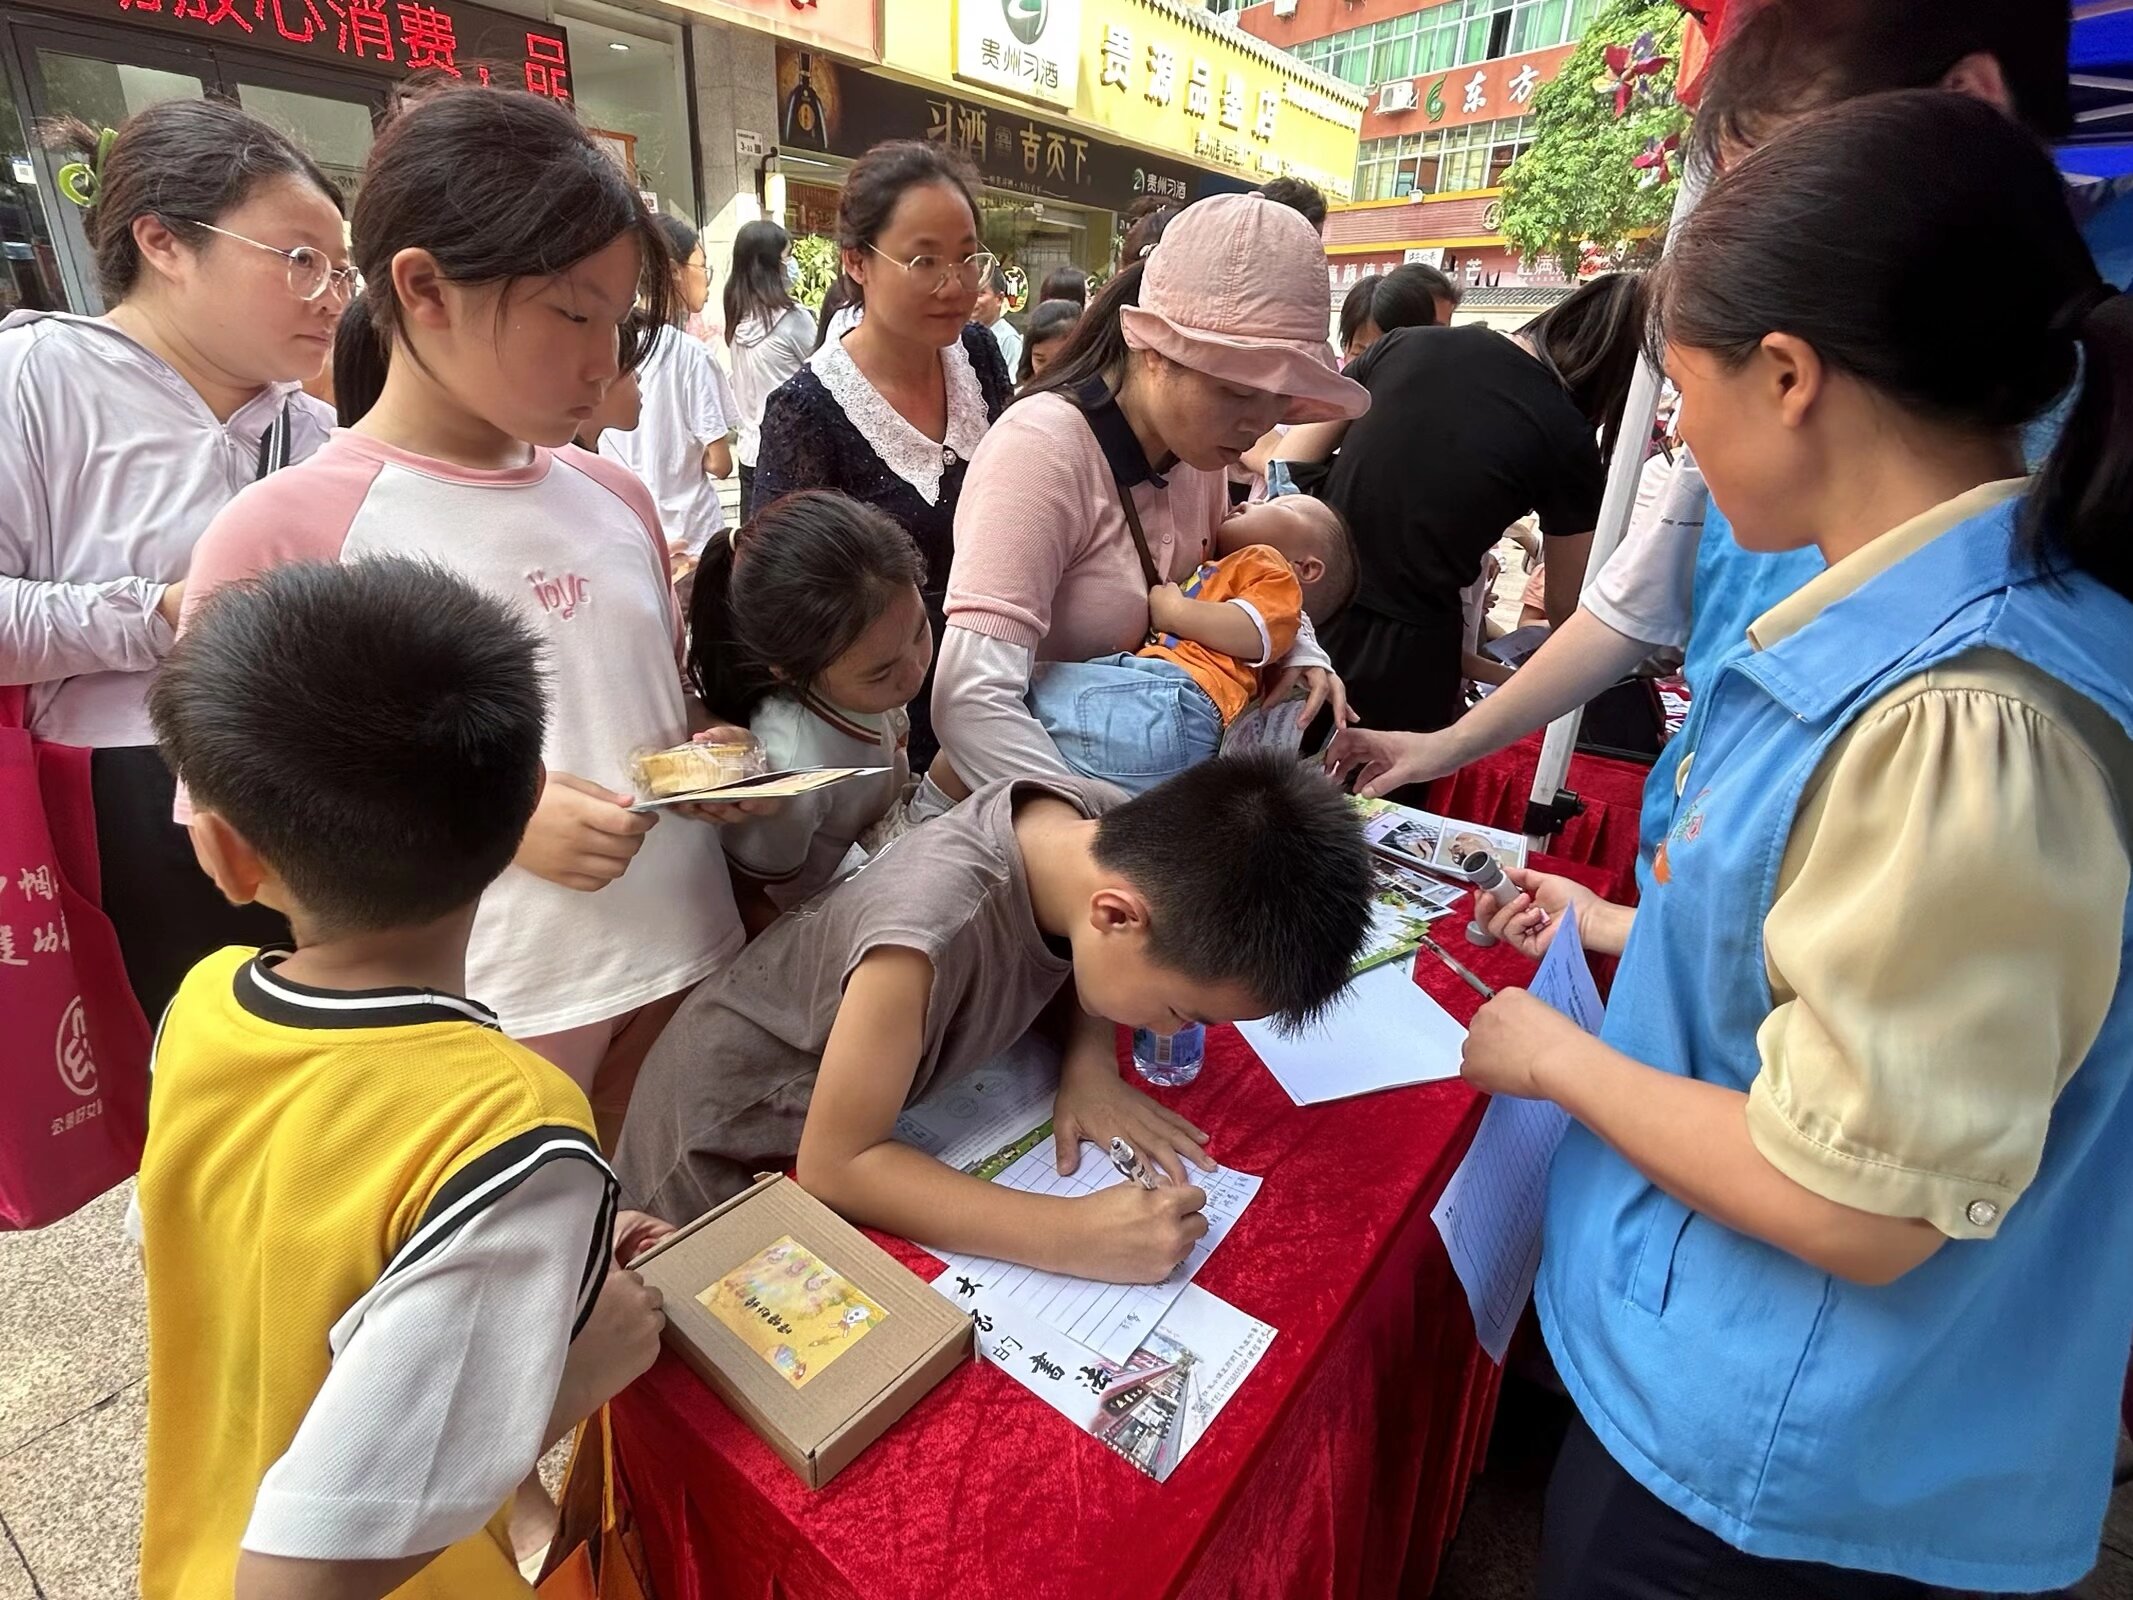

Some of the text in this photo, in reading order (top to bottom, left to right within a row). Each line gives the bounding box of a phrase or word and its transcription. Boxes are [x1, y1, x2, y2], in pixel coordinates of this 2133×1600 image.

[981, 38, 1058, 89] 贵州习酒
[1463, 64, 1539, 114] 东方
[926, 99, 988, 163] 习酒
[1146, 173, 1187, 200] 贵州习酒
